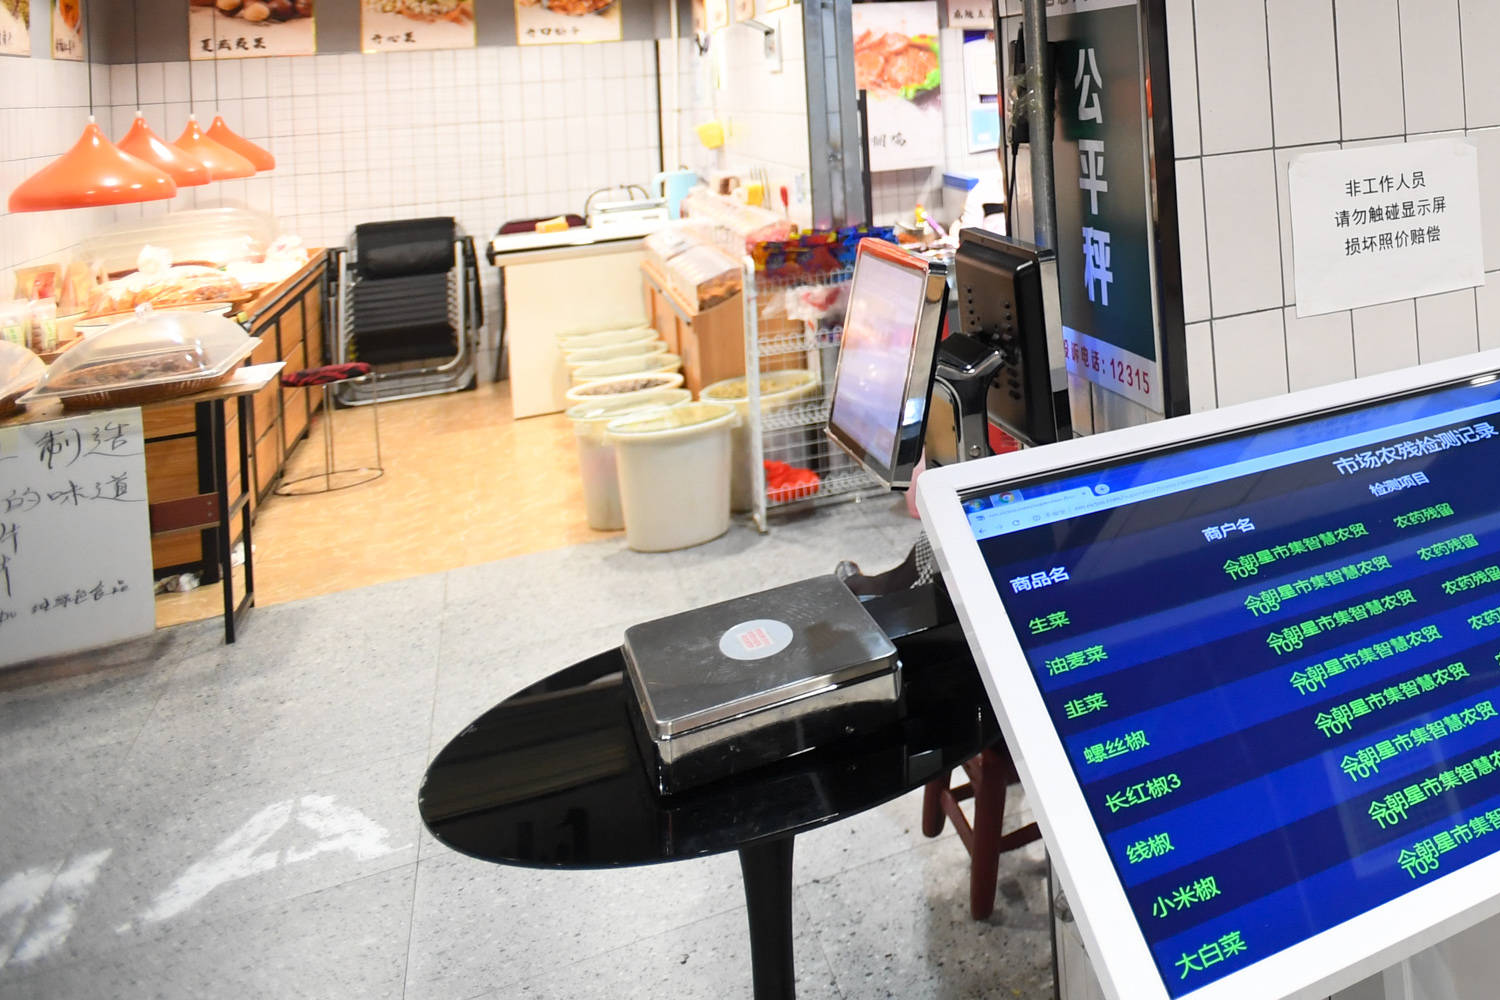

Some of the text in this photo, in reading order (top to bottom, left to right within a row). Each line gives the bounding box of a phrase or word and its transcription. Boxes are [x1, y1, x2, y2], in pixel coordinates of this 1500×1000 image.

[1074, 48, 1113, 306] 公平秤
[1345, 171, 1426, 196] 非工作人员
[1335, 196, 1446, 228] 请勿触碰显示屏
[1345, 226, 1440, 256] 损坏照价赔偿
[1333, 422, 1500, 477] 市场农残检测记录
[1010, 566, 1070, 593] 商品名
[1201, 517, 1256, 541] 商户名
[1369, 471, 1430, 497] 检测项目
[1028, 611, 1071, 634] 生菜
[1393, 502, 1455, 529] 农药残留
[1045, 645, 1109, 676] 油麦菜
[1064, 692, 1109, 719] 韭菜
[1083, 730, 1150, 765] 螺丝椒
[1105, 773, 1183, 814] 长红椒3
[1126, 832, 1175, 865] 线椒
[1151, 876, 1221, 918] 小米椒
[1176, 930, 1248, 979] 大白菜
